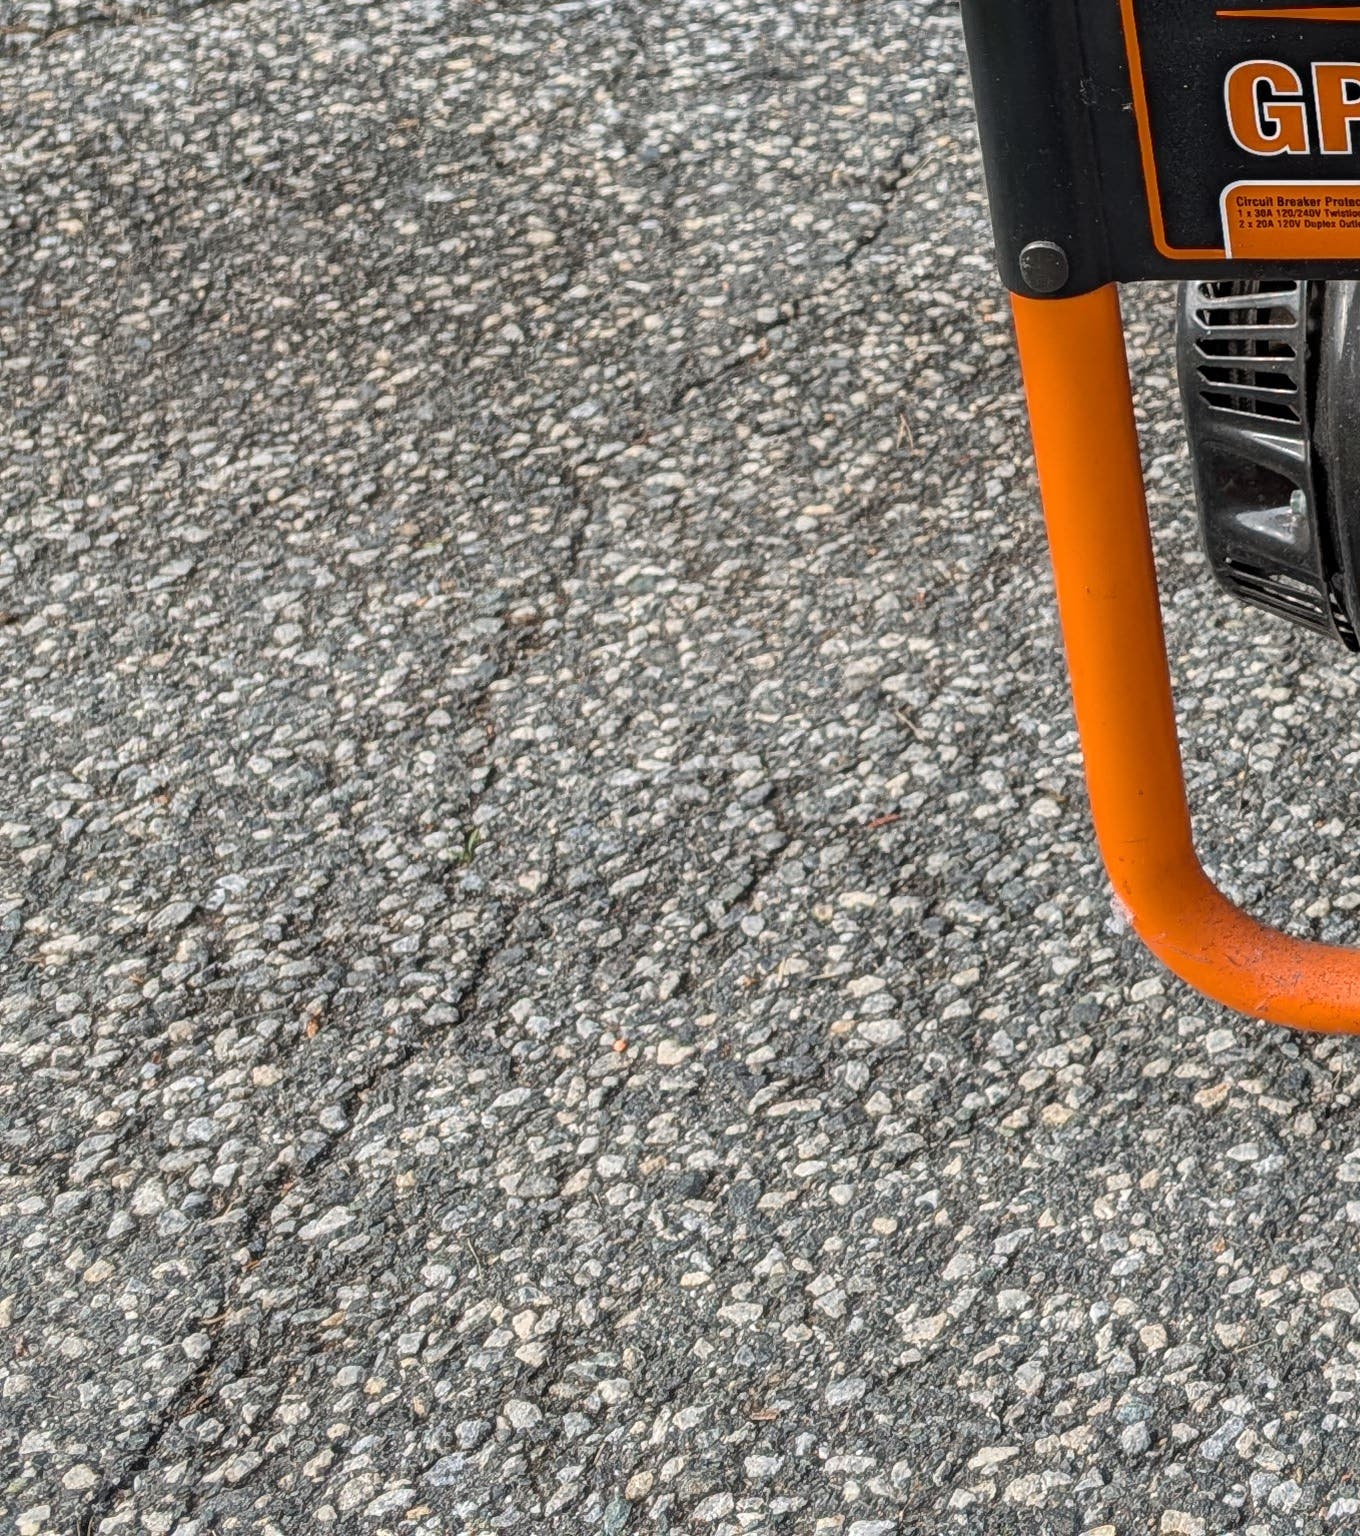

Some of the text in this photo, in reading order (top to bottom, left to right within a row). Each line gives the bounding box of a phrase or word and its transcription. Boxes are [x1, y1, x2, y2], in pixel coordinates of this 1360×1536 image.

[1236, 196, 1274, 208] Circuit
[1277, 196, 1321, 208] Breaker
[1254, 209, 1273, 218] 30A
[1276, 209, 1321, 218] 120/240V
[1239, 220, 1244, 228] 2
[1256, 220, 1274, 228] 20A
[1278, 220, 1300, 228] 120V
[1304, 220, 1336, 230] Duplex
